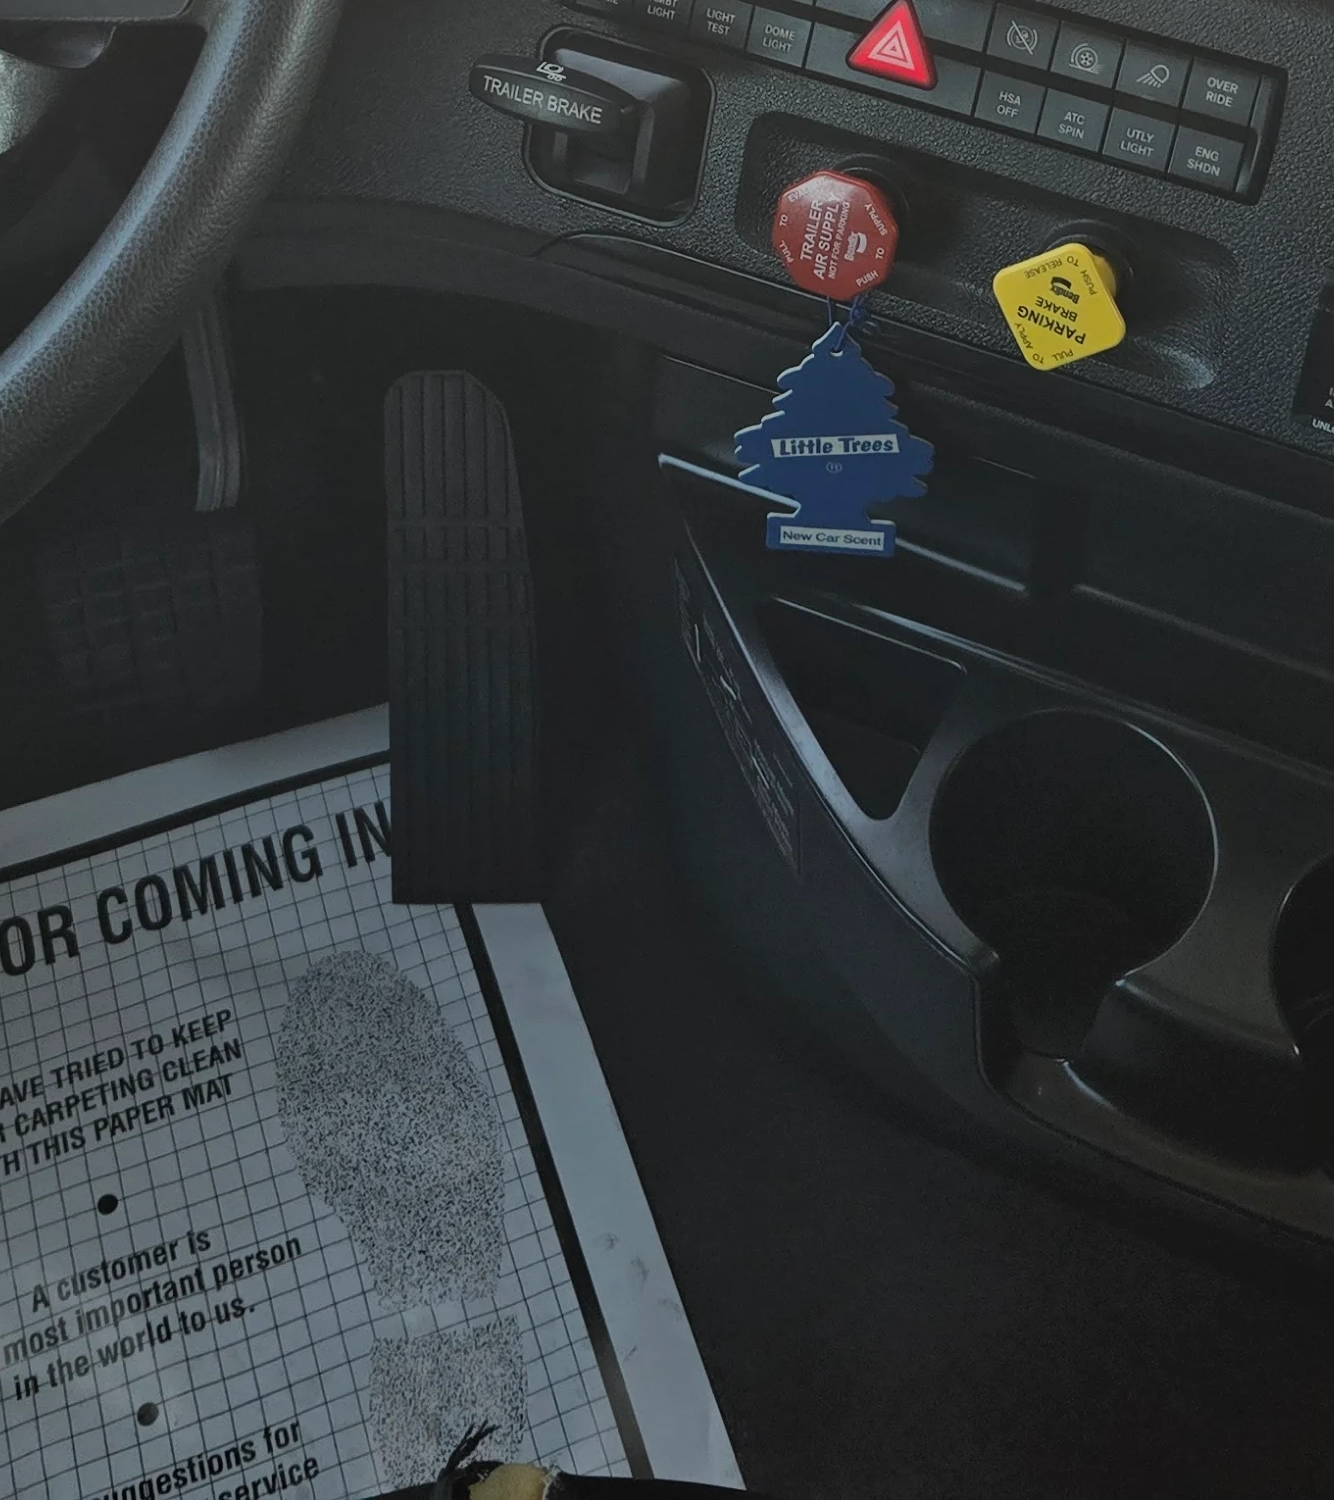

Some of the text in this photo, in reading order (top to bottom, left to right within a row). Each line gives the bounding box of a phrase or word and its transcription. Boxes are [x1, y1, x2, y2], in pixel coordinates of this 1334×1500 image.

[647, 4, 676, 21] LIGHT
[706, 8, 736, 24] LIGHT
[707, 21, 730, 36] TEST
[765, 24, 795, 41] DOME
[763, 36, 792, 52] LIGHT
[999, 91, 1021, 106] HSA
[1206, 77, 1238, 94] OVER
[484, 75, 603, 124] TRAILER BRAKE
[997, 105, 1018, 118] OFF
[1205, 91, 1233, 108] RIDE
[1058, 124, 1085, 140] SPIN
[1063, 112, 1085, 126] ATC
[1126, 128, 1154, 143] UTLY
[1120, 142, 1154, 158] LIGHT
[1195, 146, 1219, 162] ENG
[1187, 159, 1220, 176] SHDN
[779, 214, 794, 263] PULL TO
[800, 200, 823, 260] TRAILER
[828, 201, 850, 279] NOT FOR PARKING
[856, 203, 887, 287] PUSH TO SUPPLY
[813, 253, 828, 280] AIR
[1025, 256, 1097, 295] PUSH TO RELEASE
[1035, 296, 1078, 322] BRAKE
[1017, 305, 1086, 344] PARKING
[1015, 323, 1073, 364] PULL TO APPLY
[780, 438, 893, 455] Little Trees
[783, 531, 881, 546] New Car Scent
[96, 824, 324, 945] COMING
[335, 801, 392, 868] IN
[50, 1046, 125, 1090] TRIED
[131, 1033, 165, 1060] TO
[171, 1008, 232, 1049] KEEP
[14, 1068, 155, 1137] CARPETING
[162, 1038, 243, 1083] CLEAN
[26, 1126, 86, 1165] THIS
[93, 1095, 176, 1142] PAPER
[181, 1073, 234, 1111] MAT
[31, 1229, 212, 1313] A customer is
[4, 1319, 69, 1366] most
[75, 1268, 206, 1336] important
[213, 1236, 303, 1292] person
[13, 1297, 256, 1401] in the world to us.
[263, 1419, 300, 1454] for
[217, 1456, 320, 1500] service
